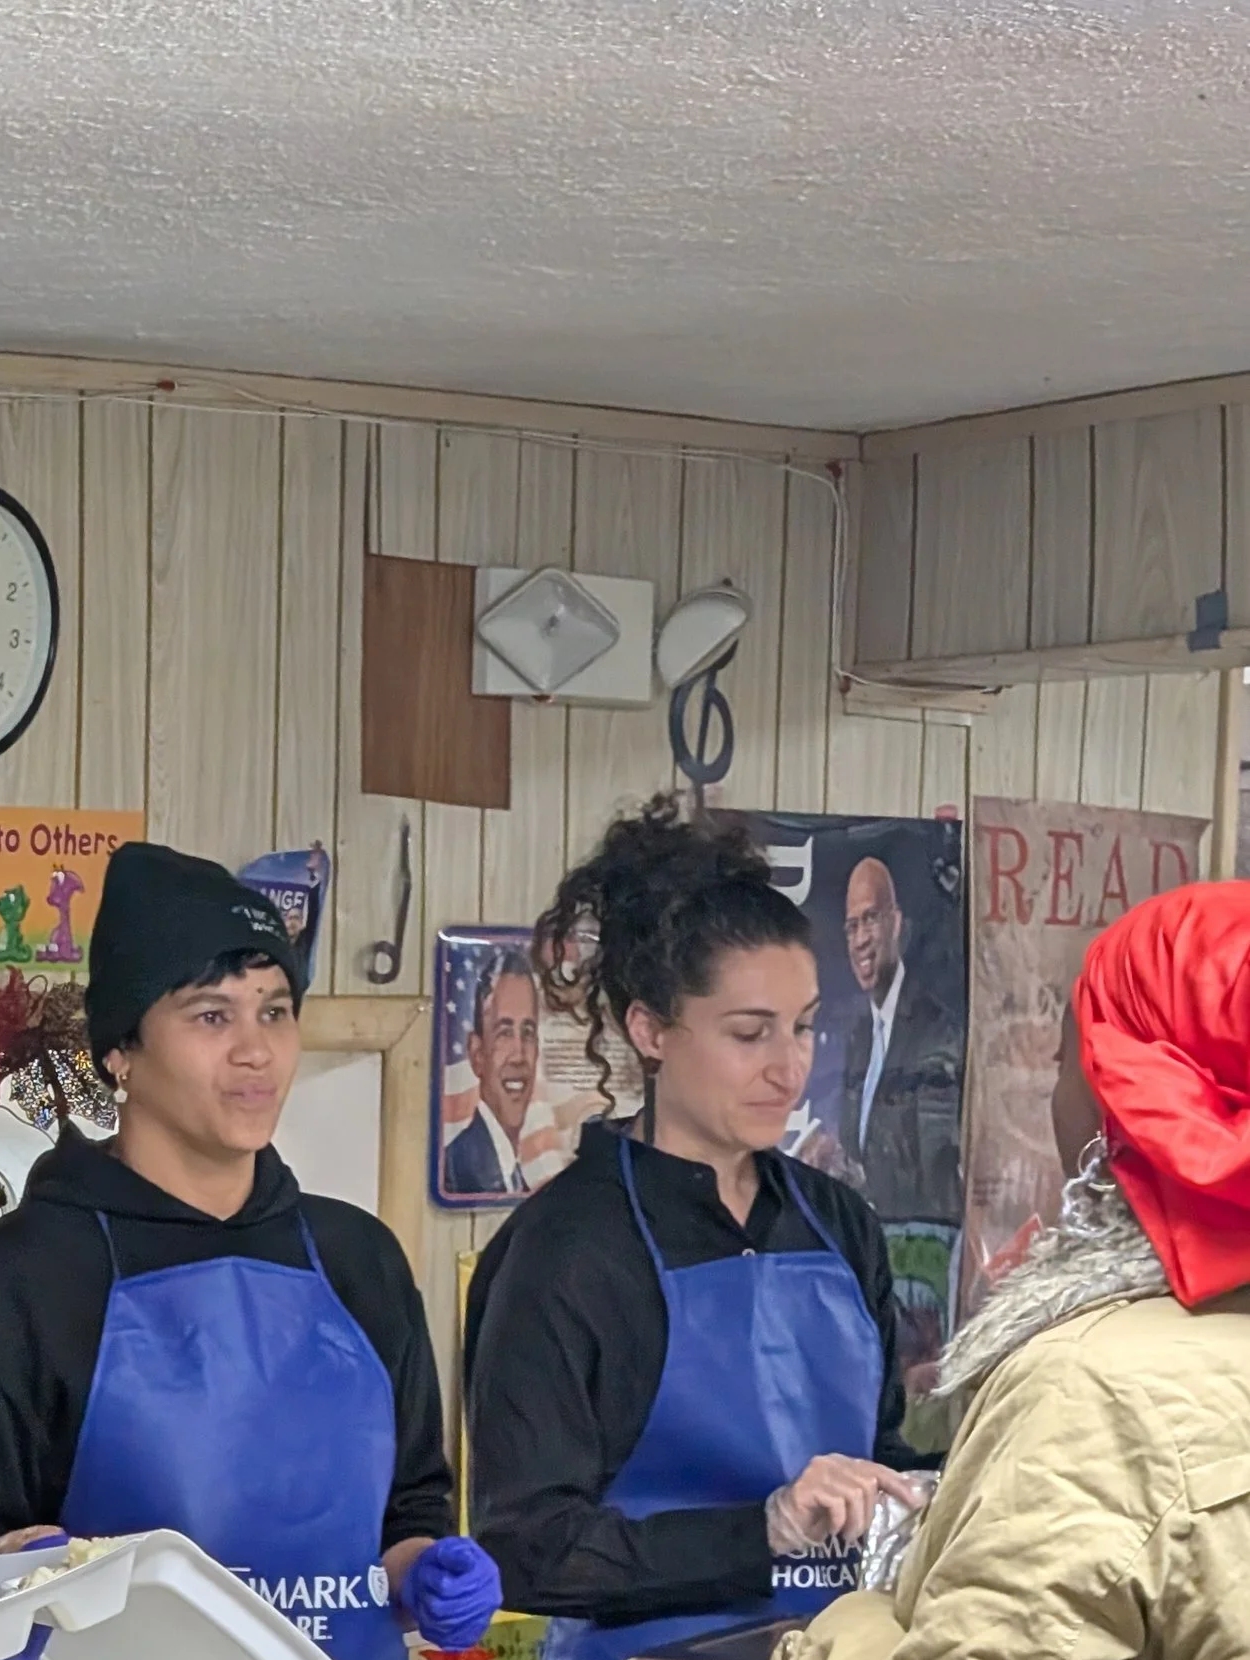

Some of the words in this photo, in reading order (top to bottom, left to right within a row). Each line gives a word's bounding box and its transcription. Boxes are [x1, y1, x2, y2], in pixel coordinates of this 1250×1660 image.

[6, 582, 17, 601] 2
[9, 629, 20, 648] 3
[30, 822, 119, 857] Others
